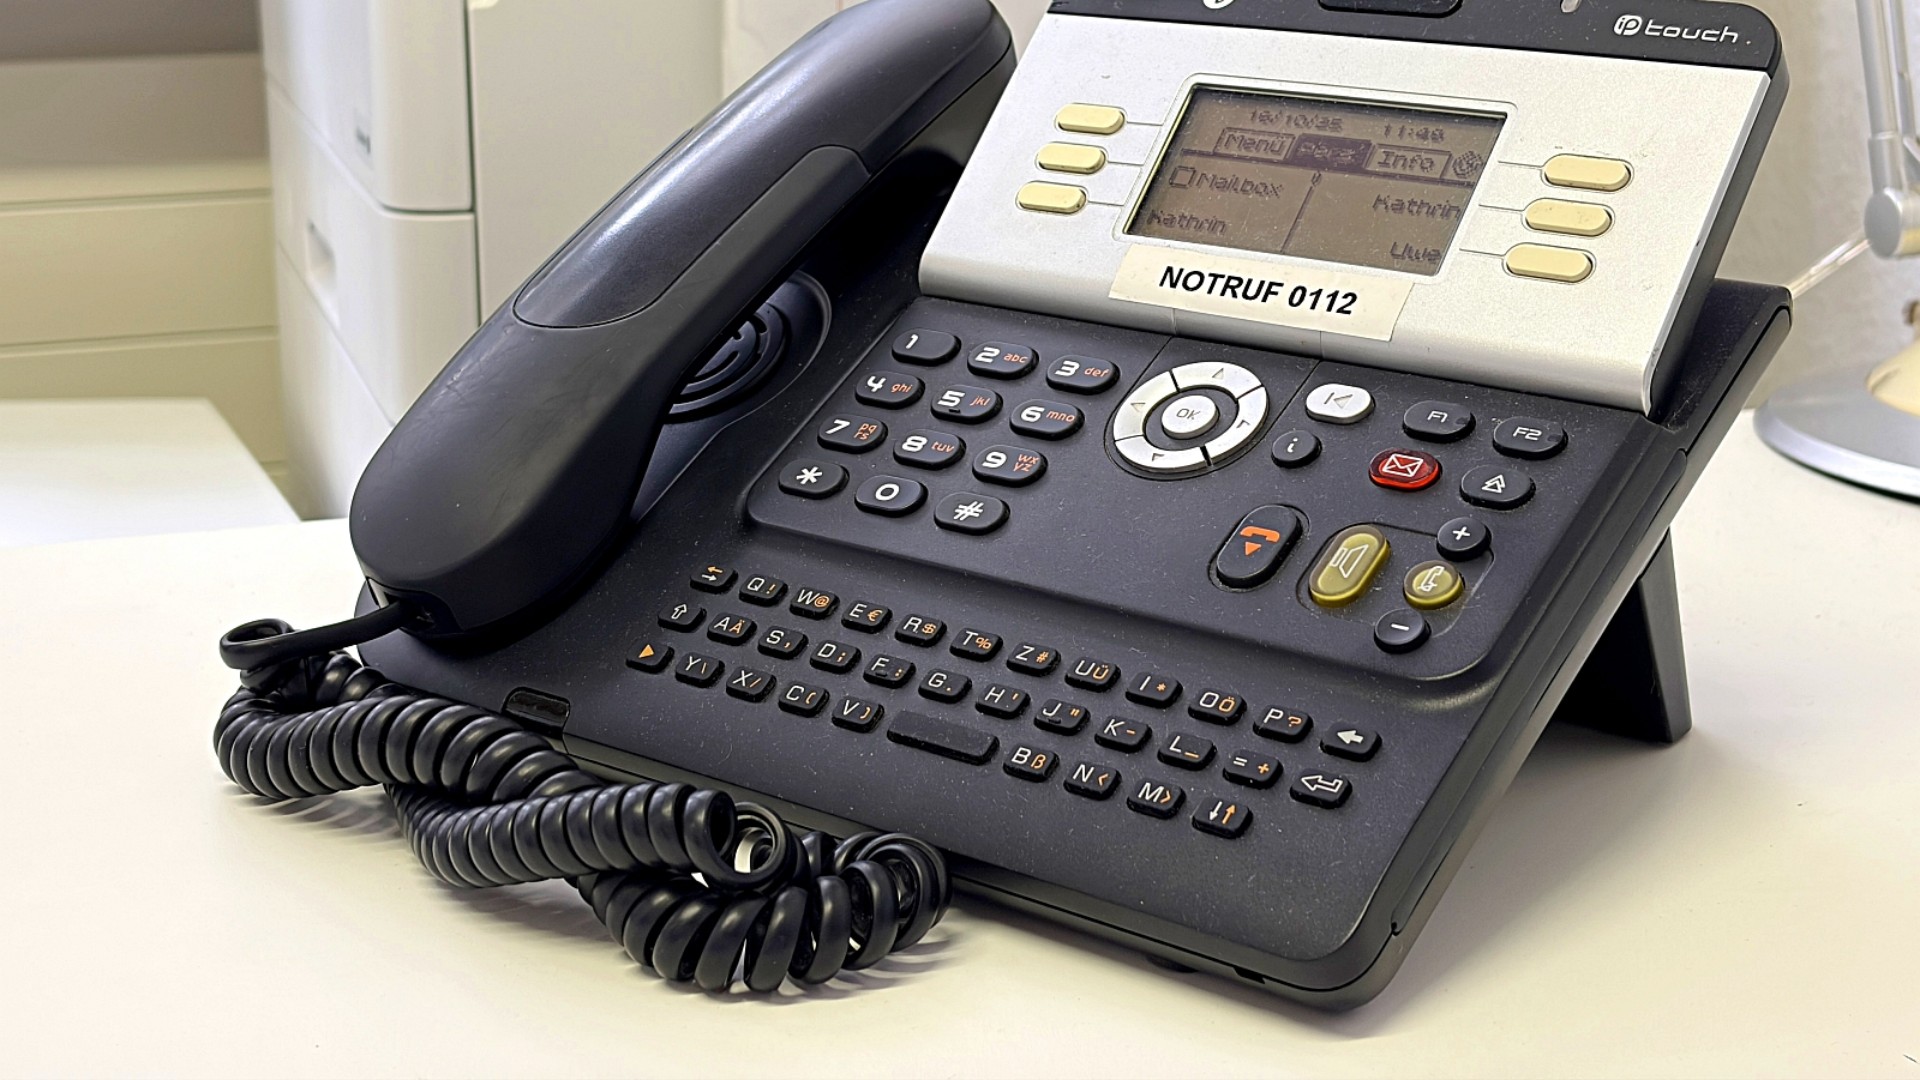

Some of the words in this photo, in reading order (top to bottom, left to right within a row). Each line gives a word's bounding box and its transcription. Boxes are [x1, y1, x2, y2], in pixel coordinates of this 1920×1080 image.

[1644, 19, 1739, 43] touch
[1223, 132, 1288, 155] Menü
[1377, 150, 1434, 172] Info
[1194, 171, 1284, 199] Mailbox
[1373, 193, 1461, 220] Kathrin
[1147, 210, 1226, 234] Kathrin
[1390, 242, 1441, 264] Uwe
[1159, 265, 1283, 303] NOTRUF
[1287, 285, 1358, 316] 0112
[906, 334, 919, 349] 1
[974, 347, 1000, 363] 2
[1003, 352, 1027, 364] abc
[1055, 361, 1080, 377] 3
[1084, 365, 1109, 378] def
[867, 375, 885, 393] 4
[891, 381, 913, 394] ghi
[938, 390, 965, 407] 5
[969, 395, 991, 407] jkl
[1020, 406, 1045, 422] 6
[1046, 410, 1076, 423] mno
[1176, 408, 1200, 420] OK
[1427, 411, 1447, 423] F1
[826, 419, 850, 434] 7
[1513, 426, 1542, 441] F2
[902, 435, 928, 452] 8
[931, 440, 954, 453] tuv
[982, 451, 1007, 468] 9
[1017, 453, 1039, 465] wx
[954, 501, 983, 520] #
